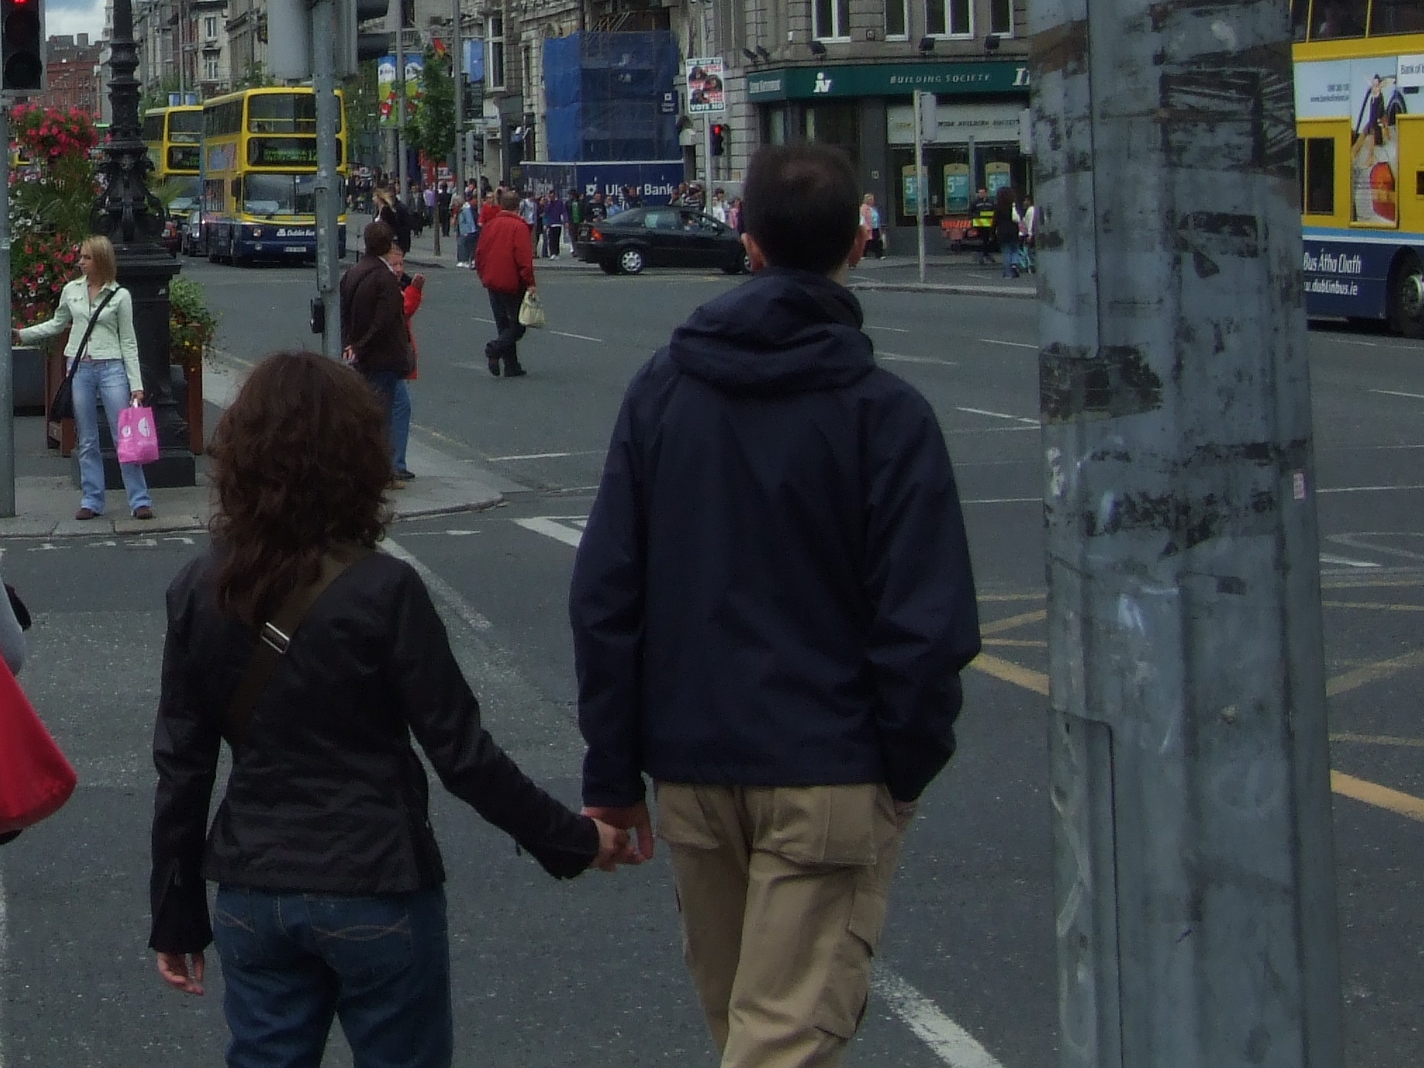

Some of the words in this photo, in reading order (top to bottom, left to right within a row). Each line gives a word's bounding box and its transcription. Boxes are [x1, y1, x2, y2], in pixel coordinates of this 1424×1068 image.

[890, 74, 941, 84] BUILDING
[946, 73, 992, 83] SOCIETY
[690, 103, 709, 111] VOTE
[605, 183, 641, 196] Ulsr
[644, 183, 674, 196] Bank
[287, 229, 305, 237] Dublin
[1303, 251, 1318, 271] Bus
[1318, 247, 1337, 273] Átha
